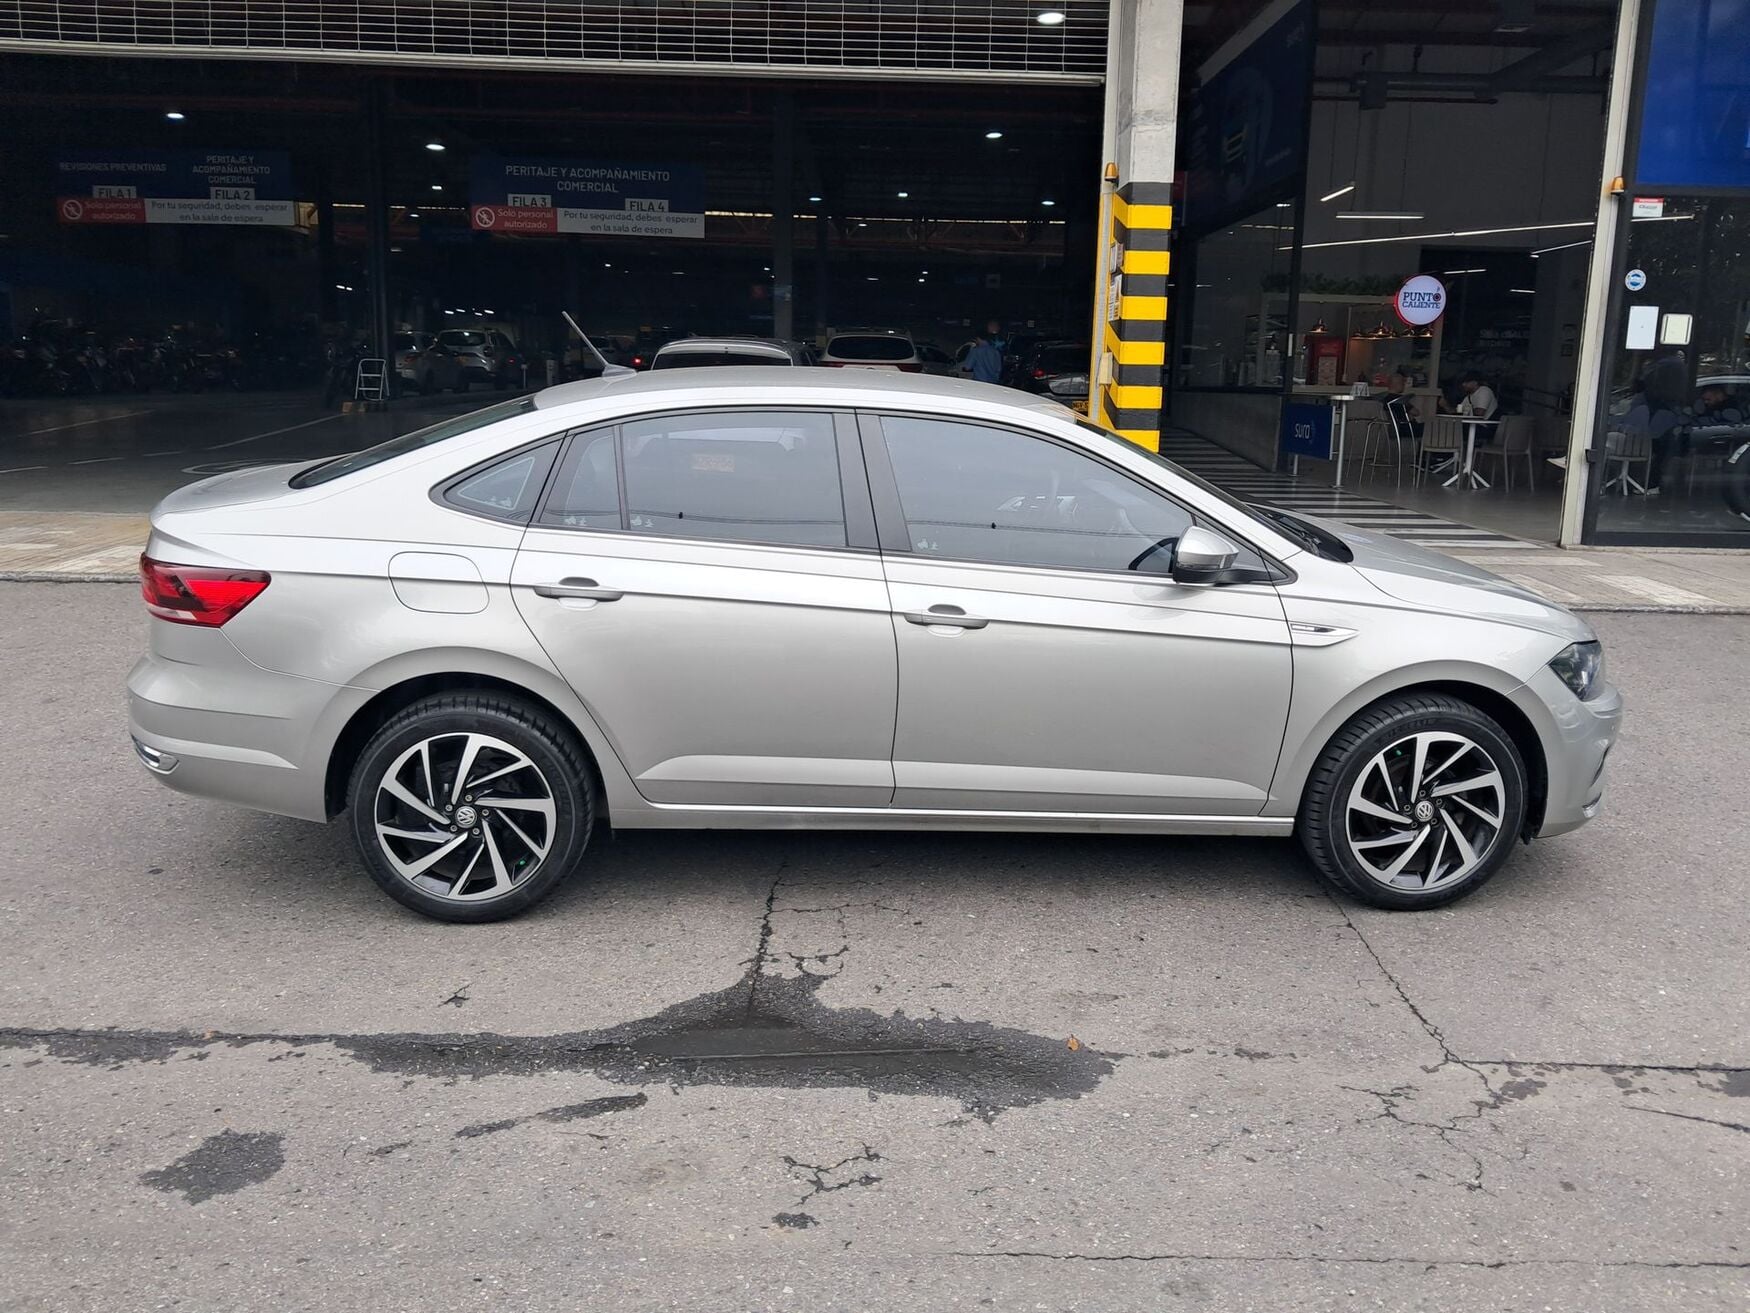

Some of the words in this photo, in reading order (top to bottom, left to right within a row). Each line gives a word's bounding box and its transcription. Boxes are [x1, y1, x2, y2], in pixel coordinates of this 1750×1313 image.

[206, 155, 248, 164] PERITAJE
[59, 162, 110, 171] REVISIONES
[110, 162, 168, 172] PREVENTIVAS
[192, 164, 271, 174] ACOMPAÑAMIENTO
[505, 165, 558, 177] PERITAJE
[559, 168, 567, 177] Y
[570, 167, 670, 182] ACOMPAÑAMIENTO
[208, 175, 256, 184] COMERCIAL
[557, 181, 619, 193] COMERCIAL
[98, 188, 124, 198] FILA
[215, 190, 240, 200] FILA
[243, 191, 250, 200] 2
[105, 202, 141, 211] personal
[152, 201, 165, 209] Por
[167, 201, 176, 209] tu
[225, 202, 251, 210] debes
[254, 204, 288, 212] esperar
[512, 196, 537, 207] FILA
[540, 197, 547, 207] 3
[630, 201, 655, 212] FILA
[658, 202, 665, 212] 4
[91, 212, 136, 220] autorizado
[233, 215, 263, 223] espera
[497, 209, 516, 217] Solo
[518, 210, 553, 219] personal
[564, 211, 578, 219] Por
[665, 216, 697, 224] esperar
[504, 220, 548, 229] autorizado
[612, 224, 629, 232] sala
[631, 225, 642, 233] de
[644, 226, 673, 235] espera
[1403, 291, 1441, 302] PUNTO
[1402, 301, 1441, 309] CALIENTE
[1294, 423, 1310, 439] sura
